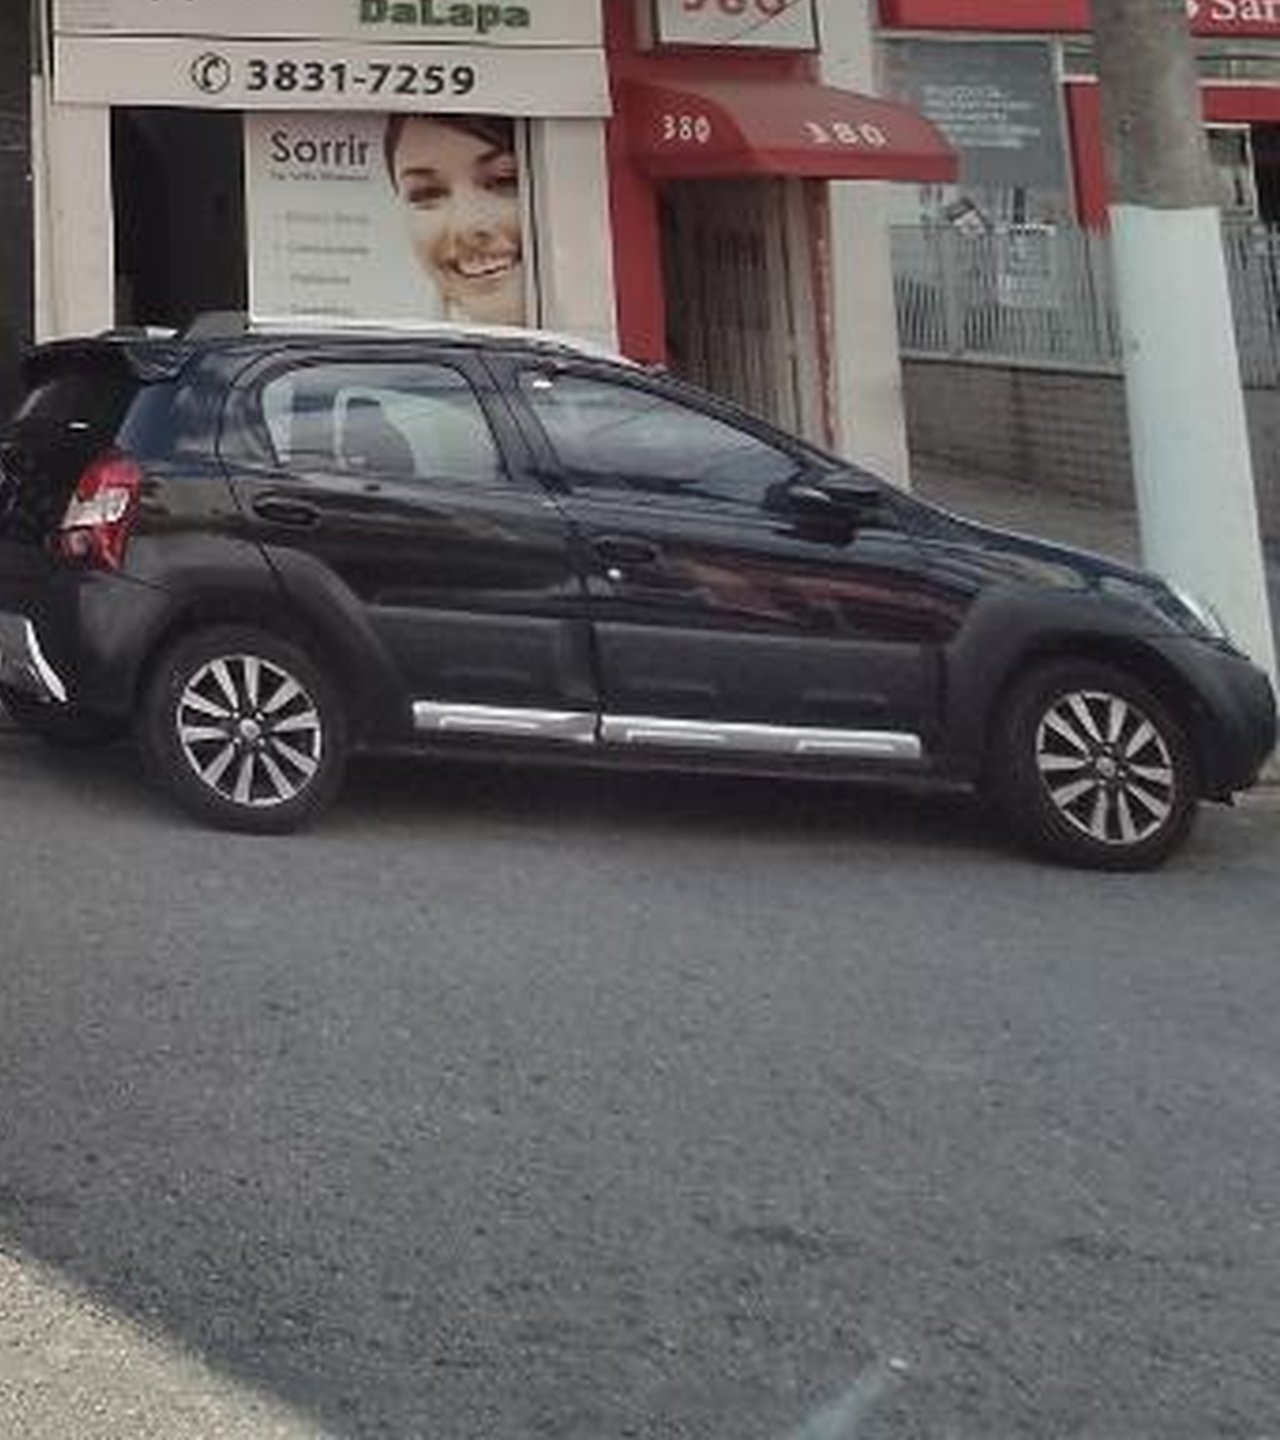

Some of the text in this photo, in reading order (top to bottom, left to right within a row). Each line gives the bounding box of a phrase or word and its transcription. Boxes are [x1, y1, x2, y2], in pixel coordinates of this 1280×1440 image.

[246, 60, 475, 95] 3831-7259
[661, 114, 712, 143] 380
[270, 129, 370, 166] Sorrir
